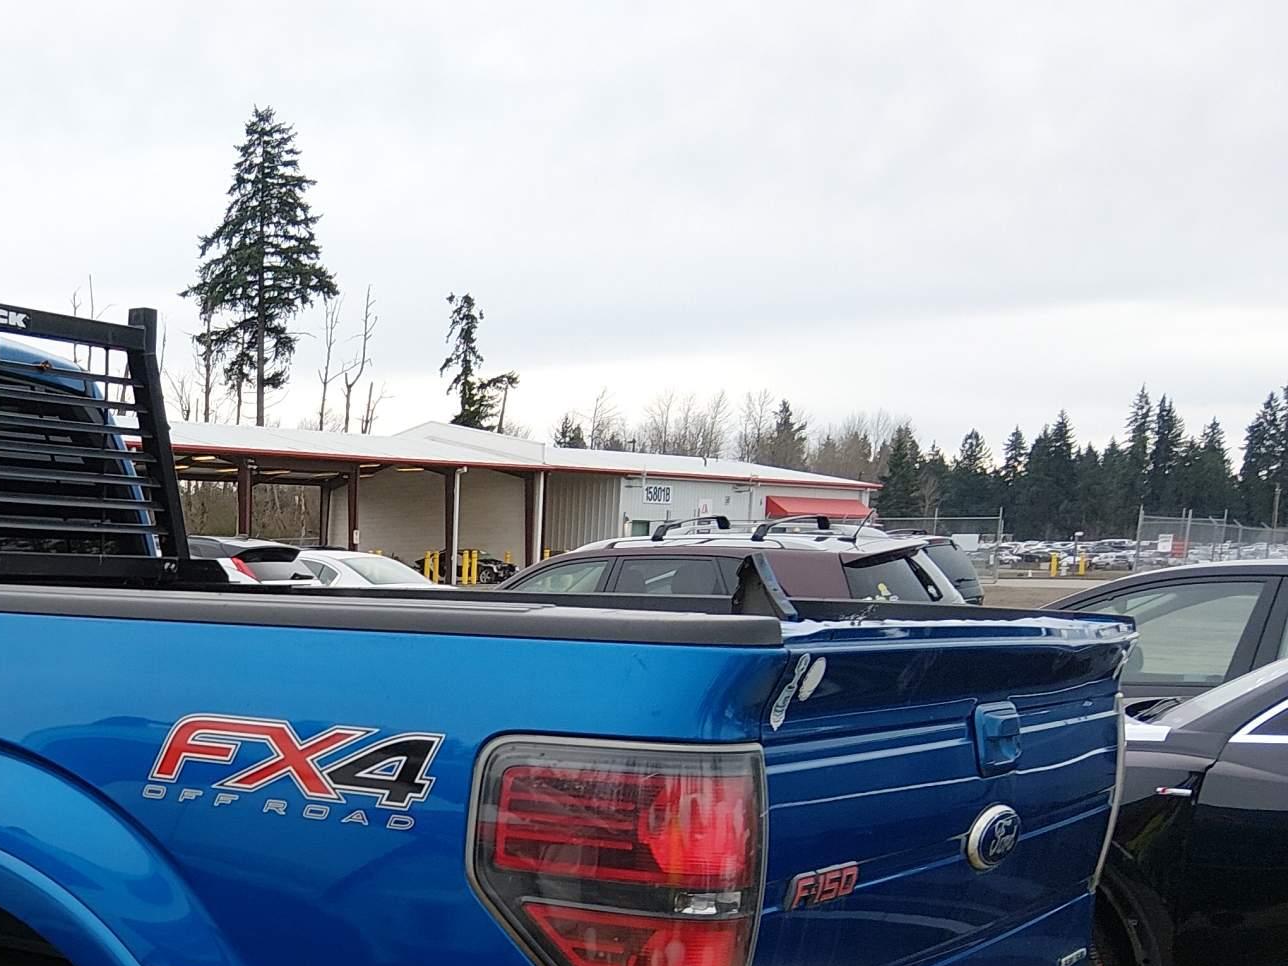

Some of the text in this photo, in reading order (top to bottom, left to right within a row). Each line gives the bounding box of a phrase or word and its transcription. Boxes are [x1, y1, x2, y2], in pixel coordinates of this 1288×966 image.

[644, 486, 672, 503] 15801B
[148, 713, 446, 810] FX4
[142, 784, 416, 831] OFF ROAD
[989, 814, 1018, 857] Ford
[790, 863, 859, 909] F-150
